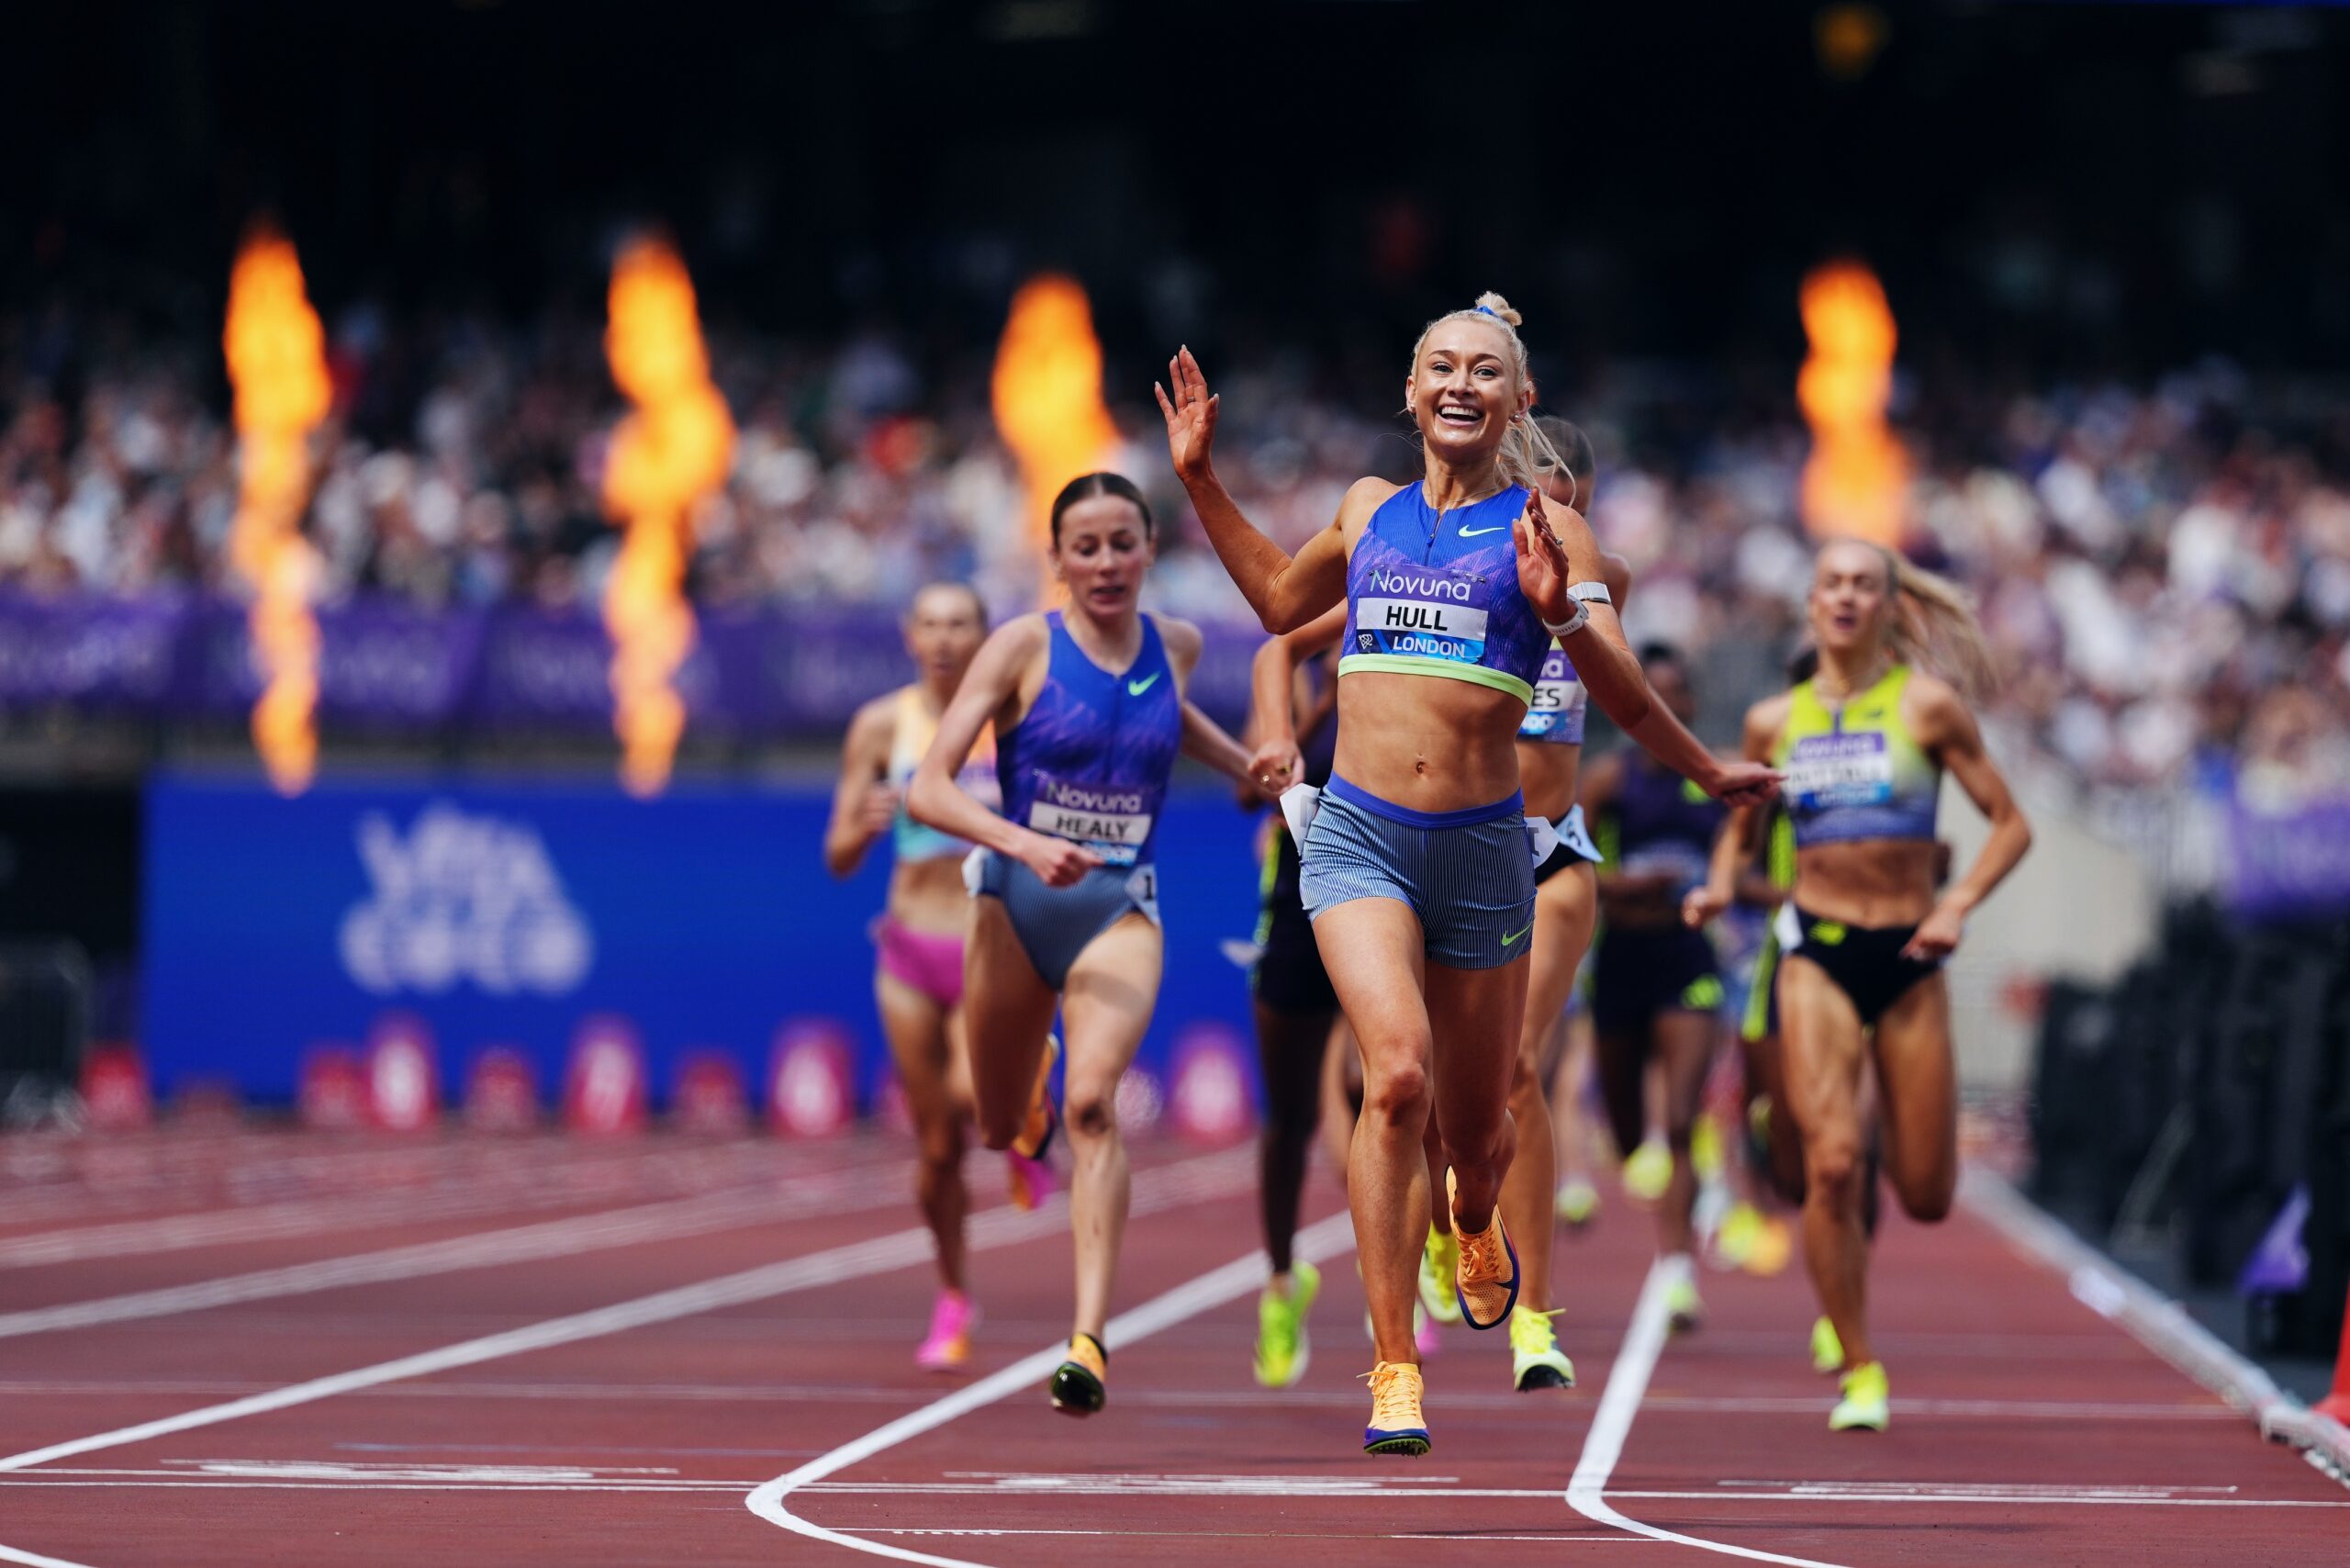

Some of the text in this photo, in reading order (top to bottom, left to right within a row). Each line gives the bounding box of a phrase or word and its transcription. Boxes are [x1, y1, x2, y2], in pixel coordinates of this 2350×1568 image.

[1370, 569, 1472, 601] Novuna
[1385, 605, 1449, 632] HULL
[1393, 636, 1465, 658] LONDON
[1047, 782, 1141, 812] Novuna
[1056, 812, 1131, 839] HEALY
